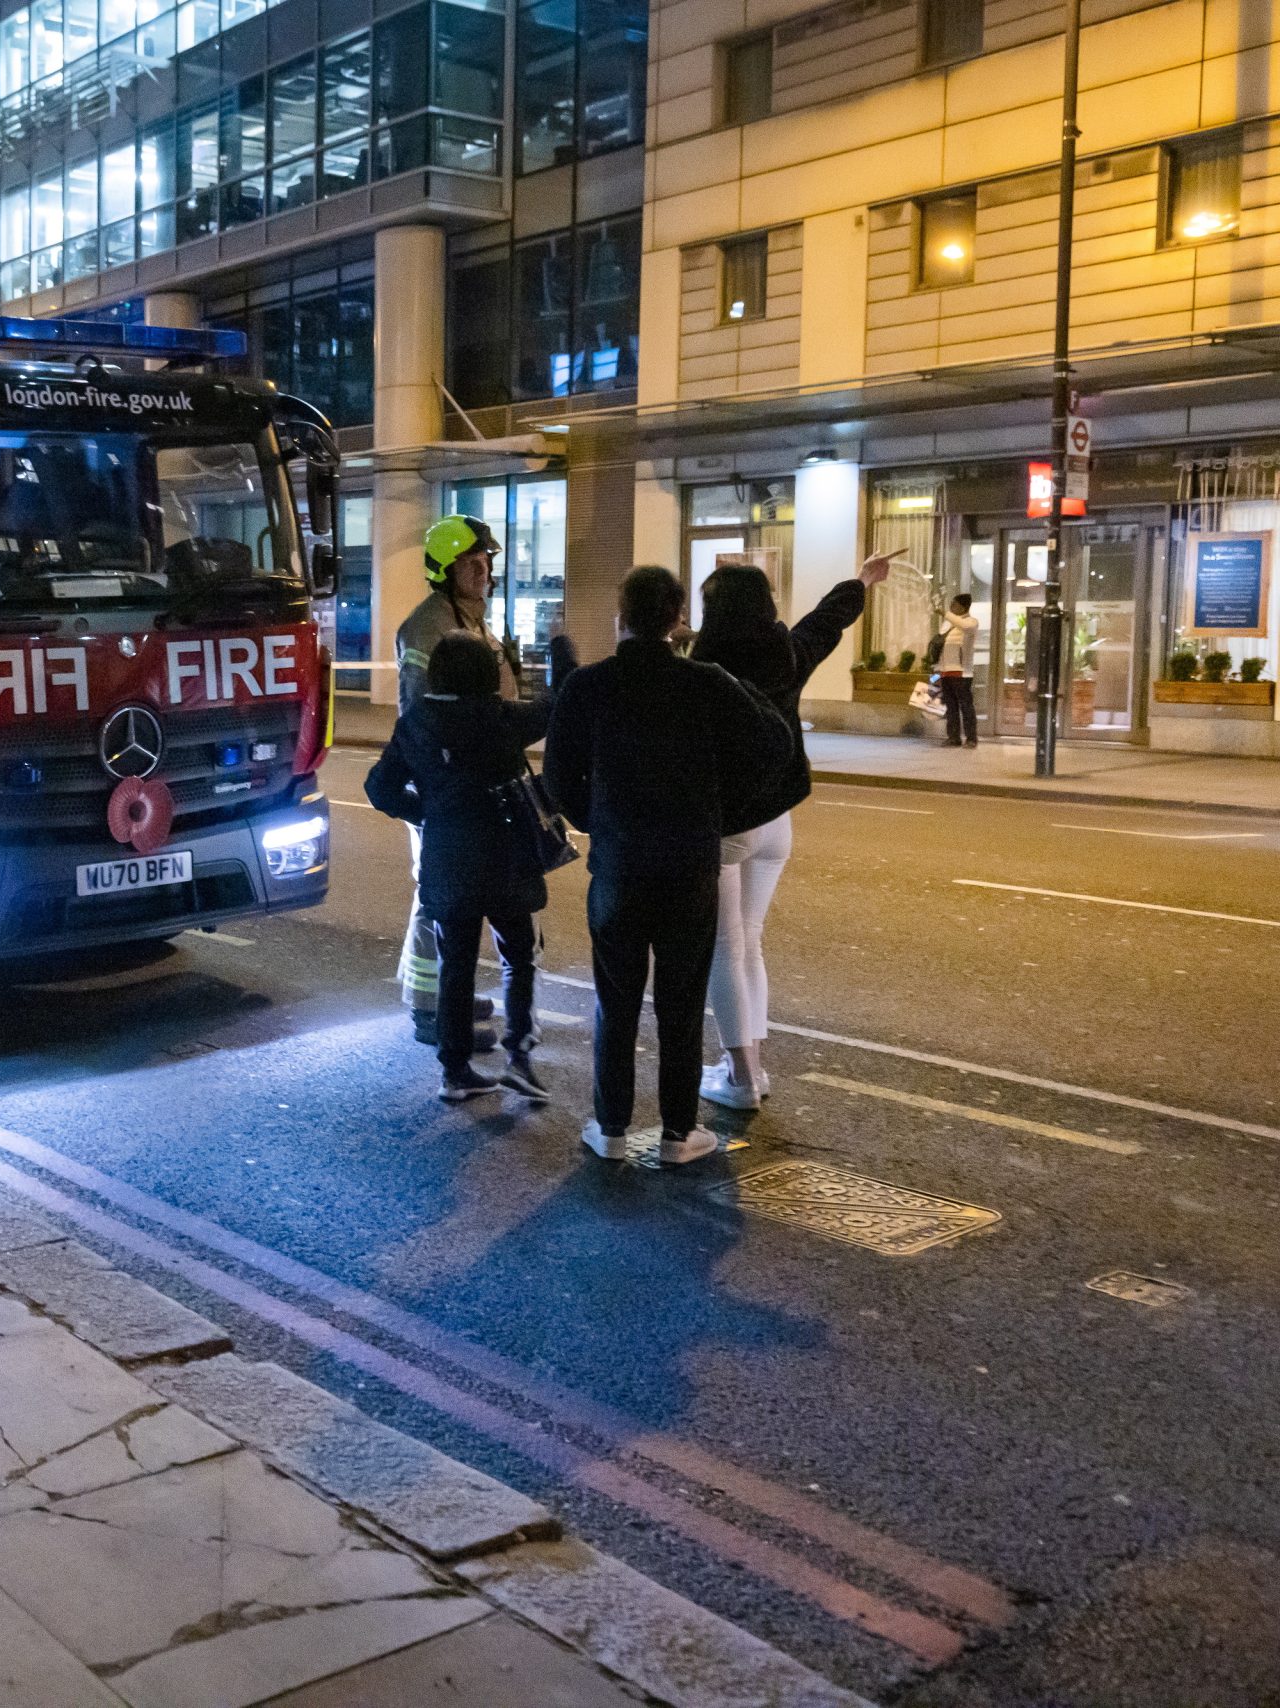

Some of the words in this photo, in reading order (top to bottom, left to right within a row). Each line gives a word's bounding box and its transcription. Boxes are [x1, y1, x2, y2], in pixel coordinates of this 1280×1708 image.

[4, 383, 194, 415] london-fire.gov.uk
[166, 634, 298, 704] FIRE
[146, 857, 184, 882] BFN
